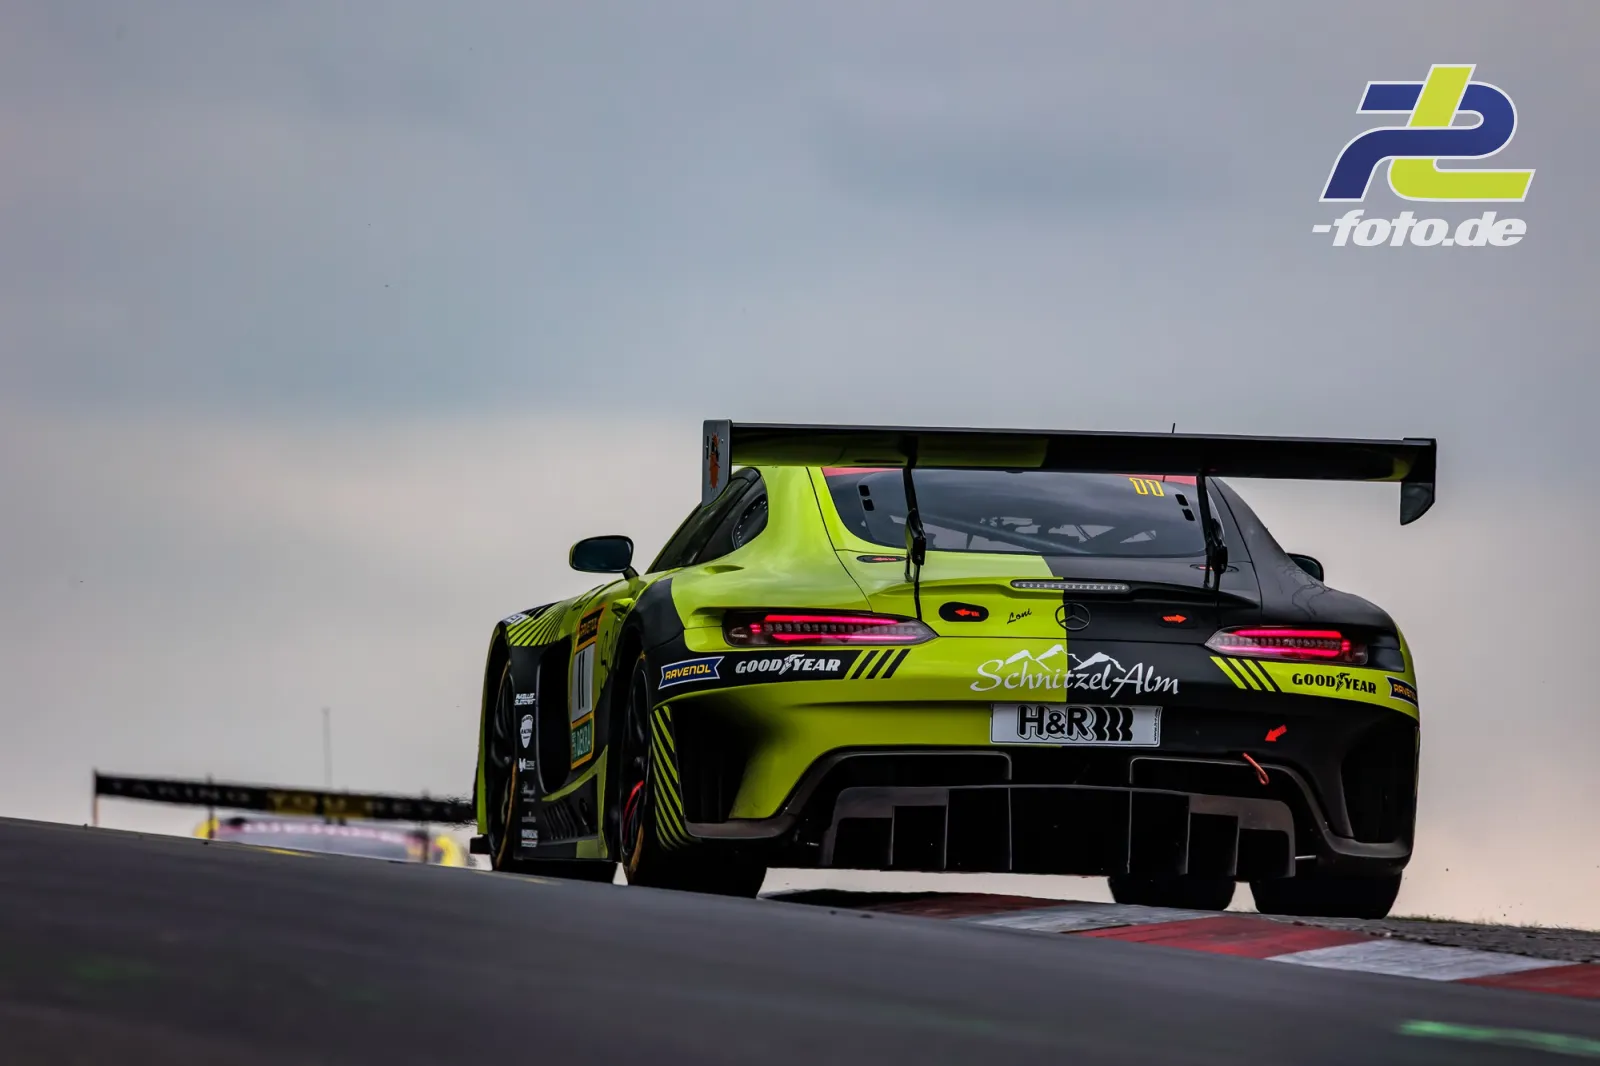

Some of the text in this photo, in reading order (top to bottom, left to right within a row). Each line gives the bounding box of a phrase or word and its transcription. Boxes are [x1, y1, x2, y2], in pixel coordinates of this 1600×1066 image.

[665, 664, 712, 680] RAVENOL
[735, 653, 841, 675] GOODYEAR
[1291, 673, 1377, 694] GOODYEAR
[1016, 704, 1097, 741] H&R
